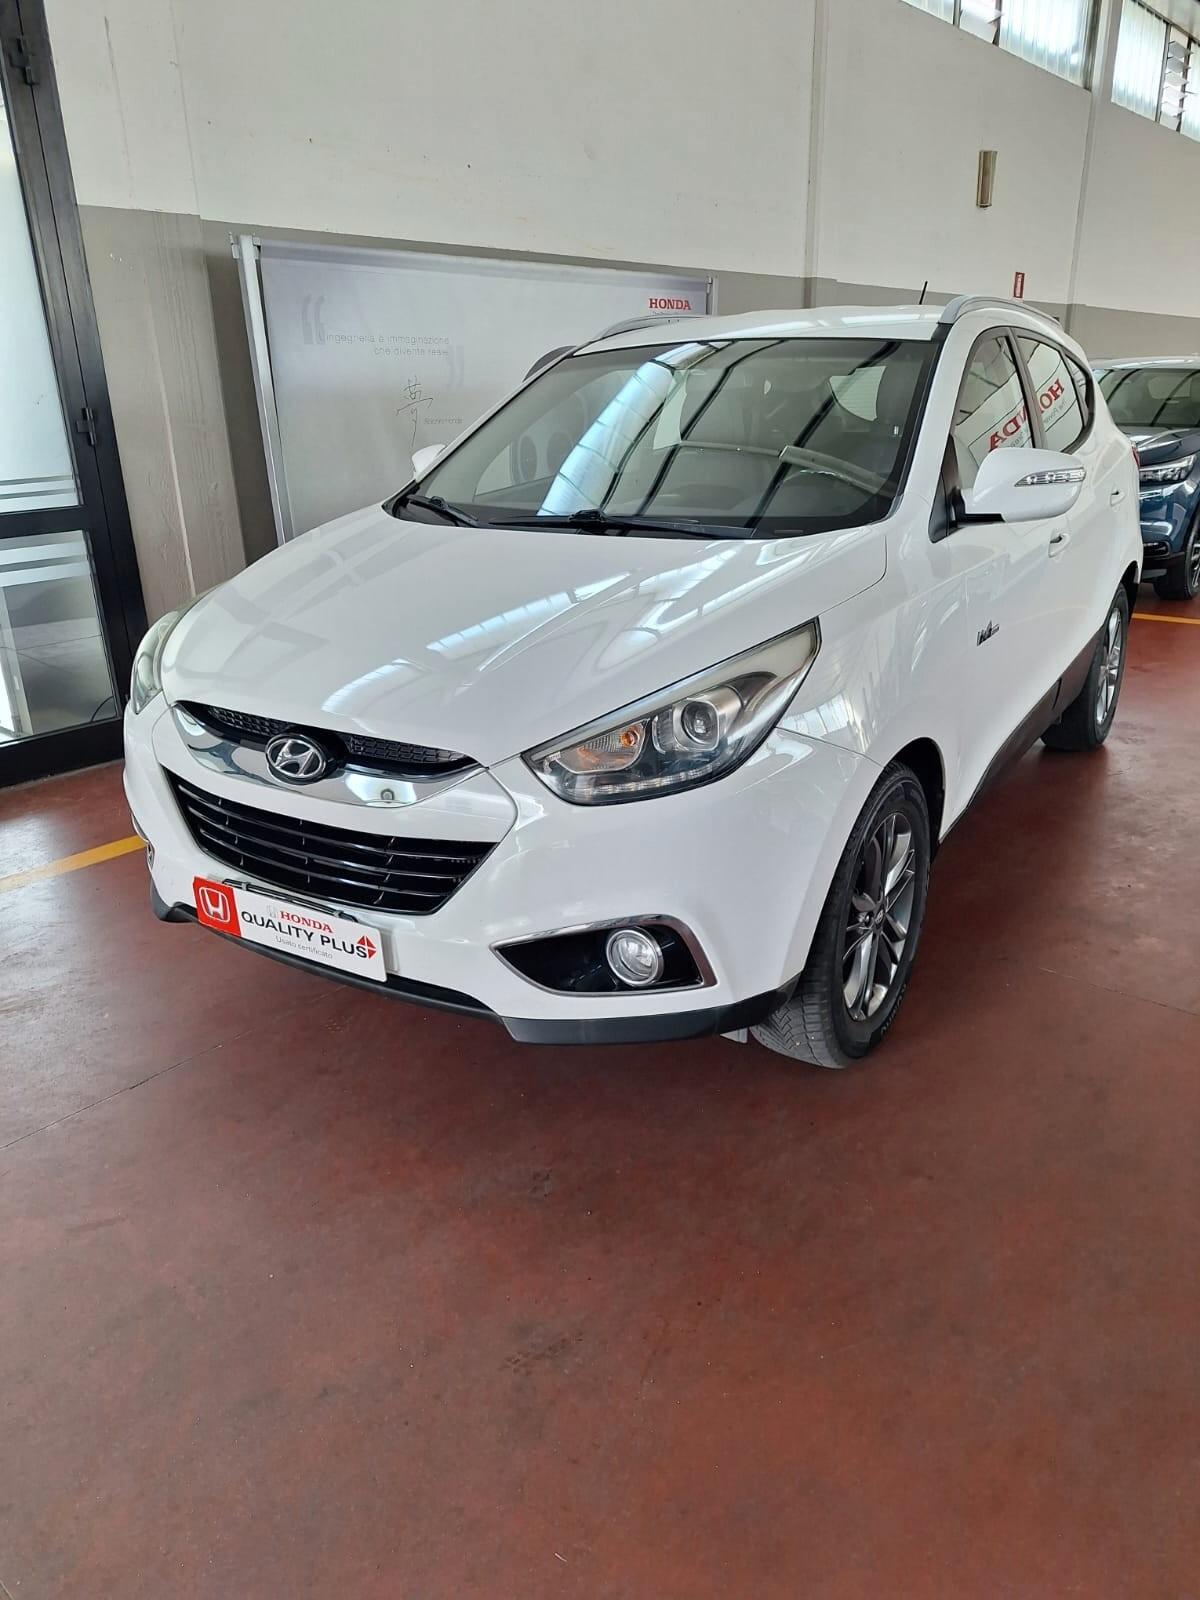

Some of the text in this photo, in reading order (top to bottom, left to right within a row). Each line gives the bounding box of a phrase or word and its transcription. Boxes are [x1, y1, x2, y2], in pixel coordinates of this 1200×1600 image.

[648, 298, 692, 311] HONDA
[280, 910, 333, 933] HONDA
[241, 910, 368, 959] QUALITY PLUS
[275, 935, 333, 959] Usato certificato
